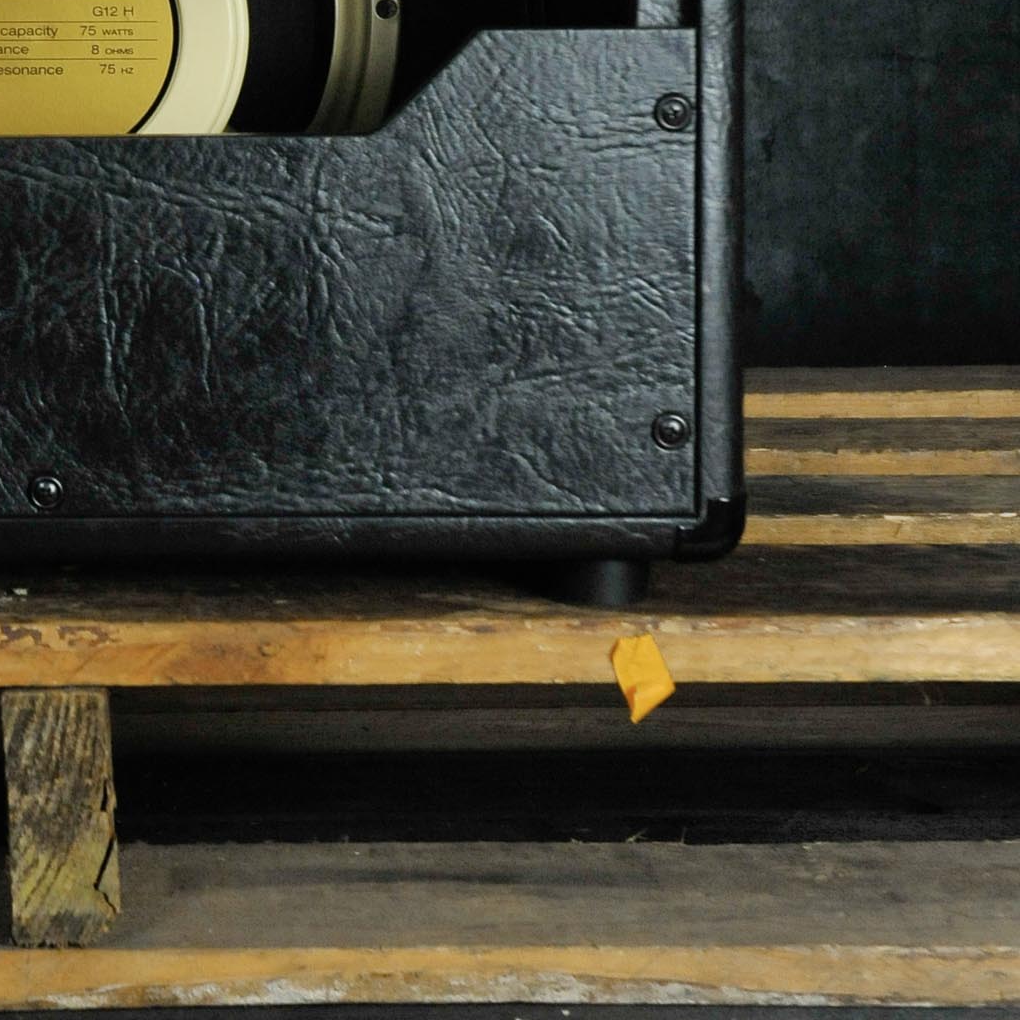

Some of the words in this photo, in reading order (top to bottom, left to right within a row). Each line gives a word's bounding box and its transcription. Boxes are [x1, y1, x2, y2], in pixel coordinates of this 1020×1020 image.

[92, 6, 118, 17] G12
[124, 6, 134, 17] H
[0, 25, 59, 39] capacity
[80, 25, 96, 36] 75
[102, 28, 134, 36] WATTS
[91, 44, 99, 55] 8
[105, 47, 134, 55] OHMS
[99, 64, 116, 75] 75
